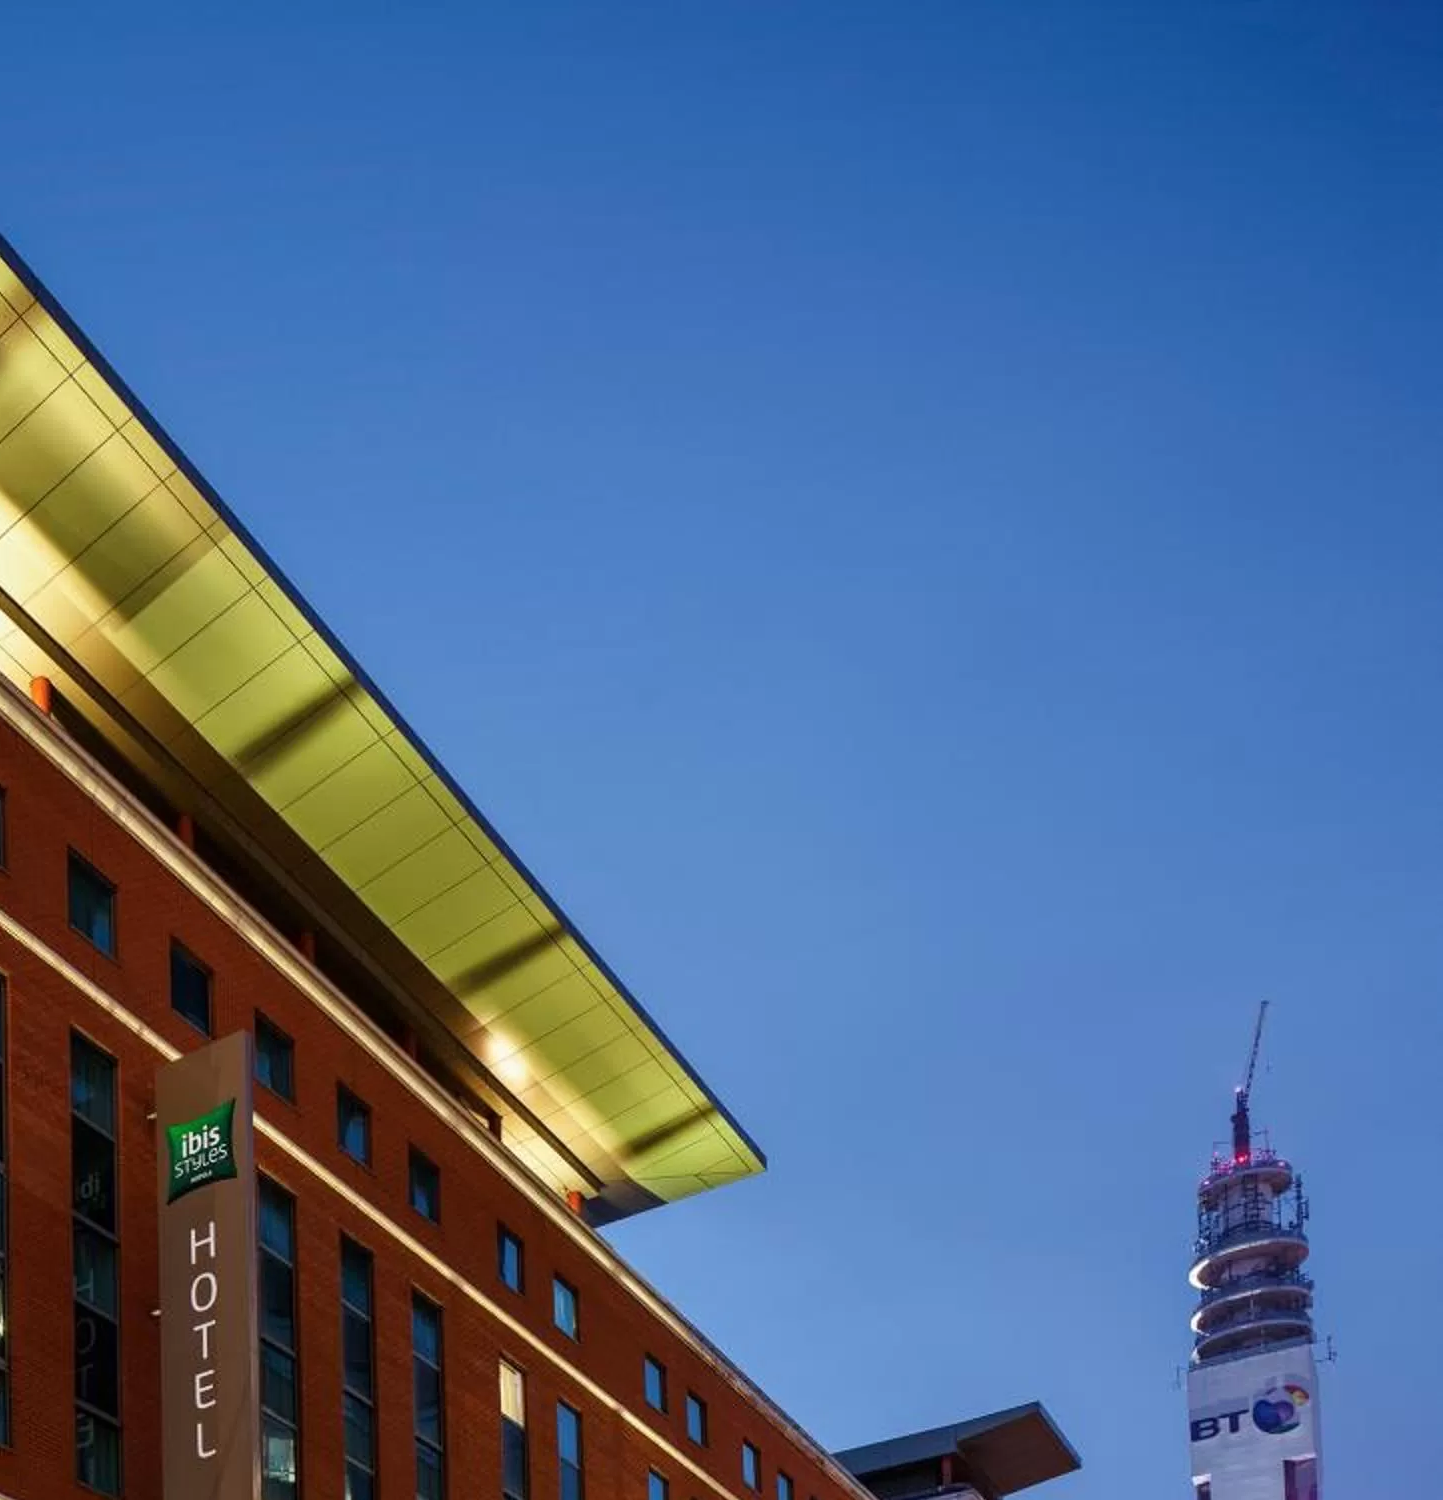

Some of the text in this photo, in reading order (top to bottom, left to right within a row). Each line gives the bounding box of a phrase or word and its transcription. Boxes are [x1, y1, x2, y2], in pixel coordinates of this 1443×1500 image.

[181, 1124, 220, 1158] ibis
[190, 1221, 218, 1459] HOTEL
[1190, 1409, 1250, 1442] BT
